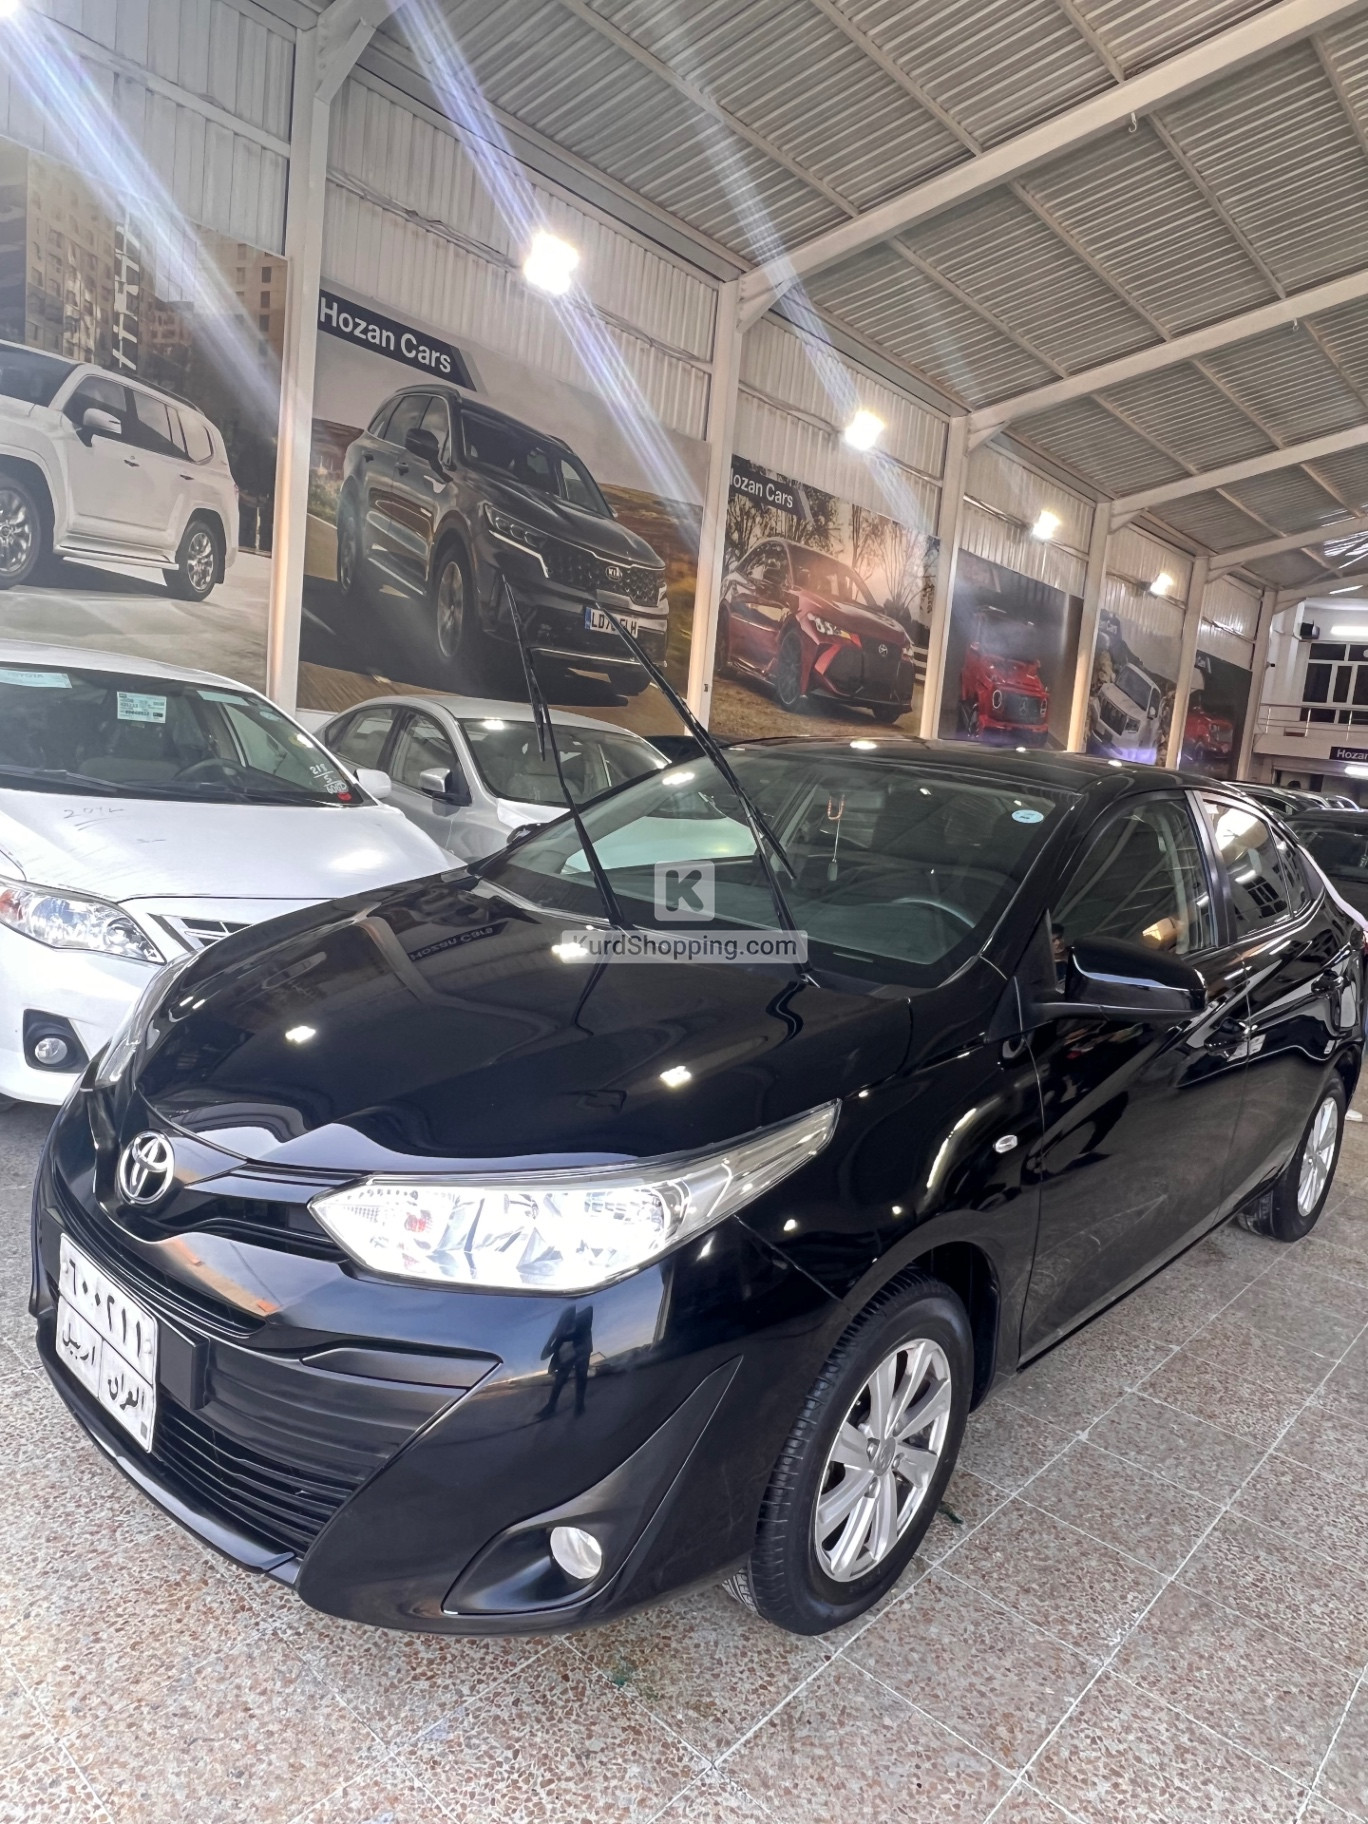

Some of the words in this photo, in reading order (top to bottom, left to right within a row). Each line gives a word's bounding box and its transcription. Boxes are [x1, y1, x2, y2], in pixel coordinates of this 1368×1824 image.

[320, 297, 395, 350] Hozan
[400, 333, 451, 373] Cars
[765, 483, 793, 508] Cars
